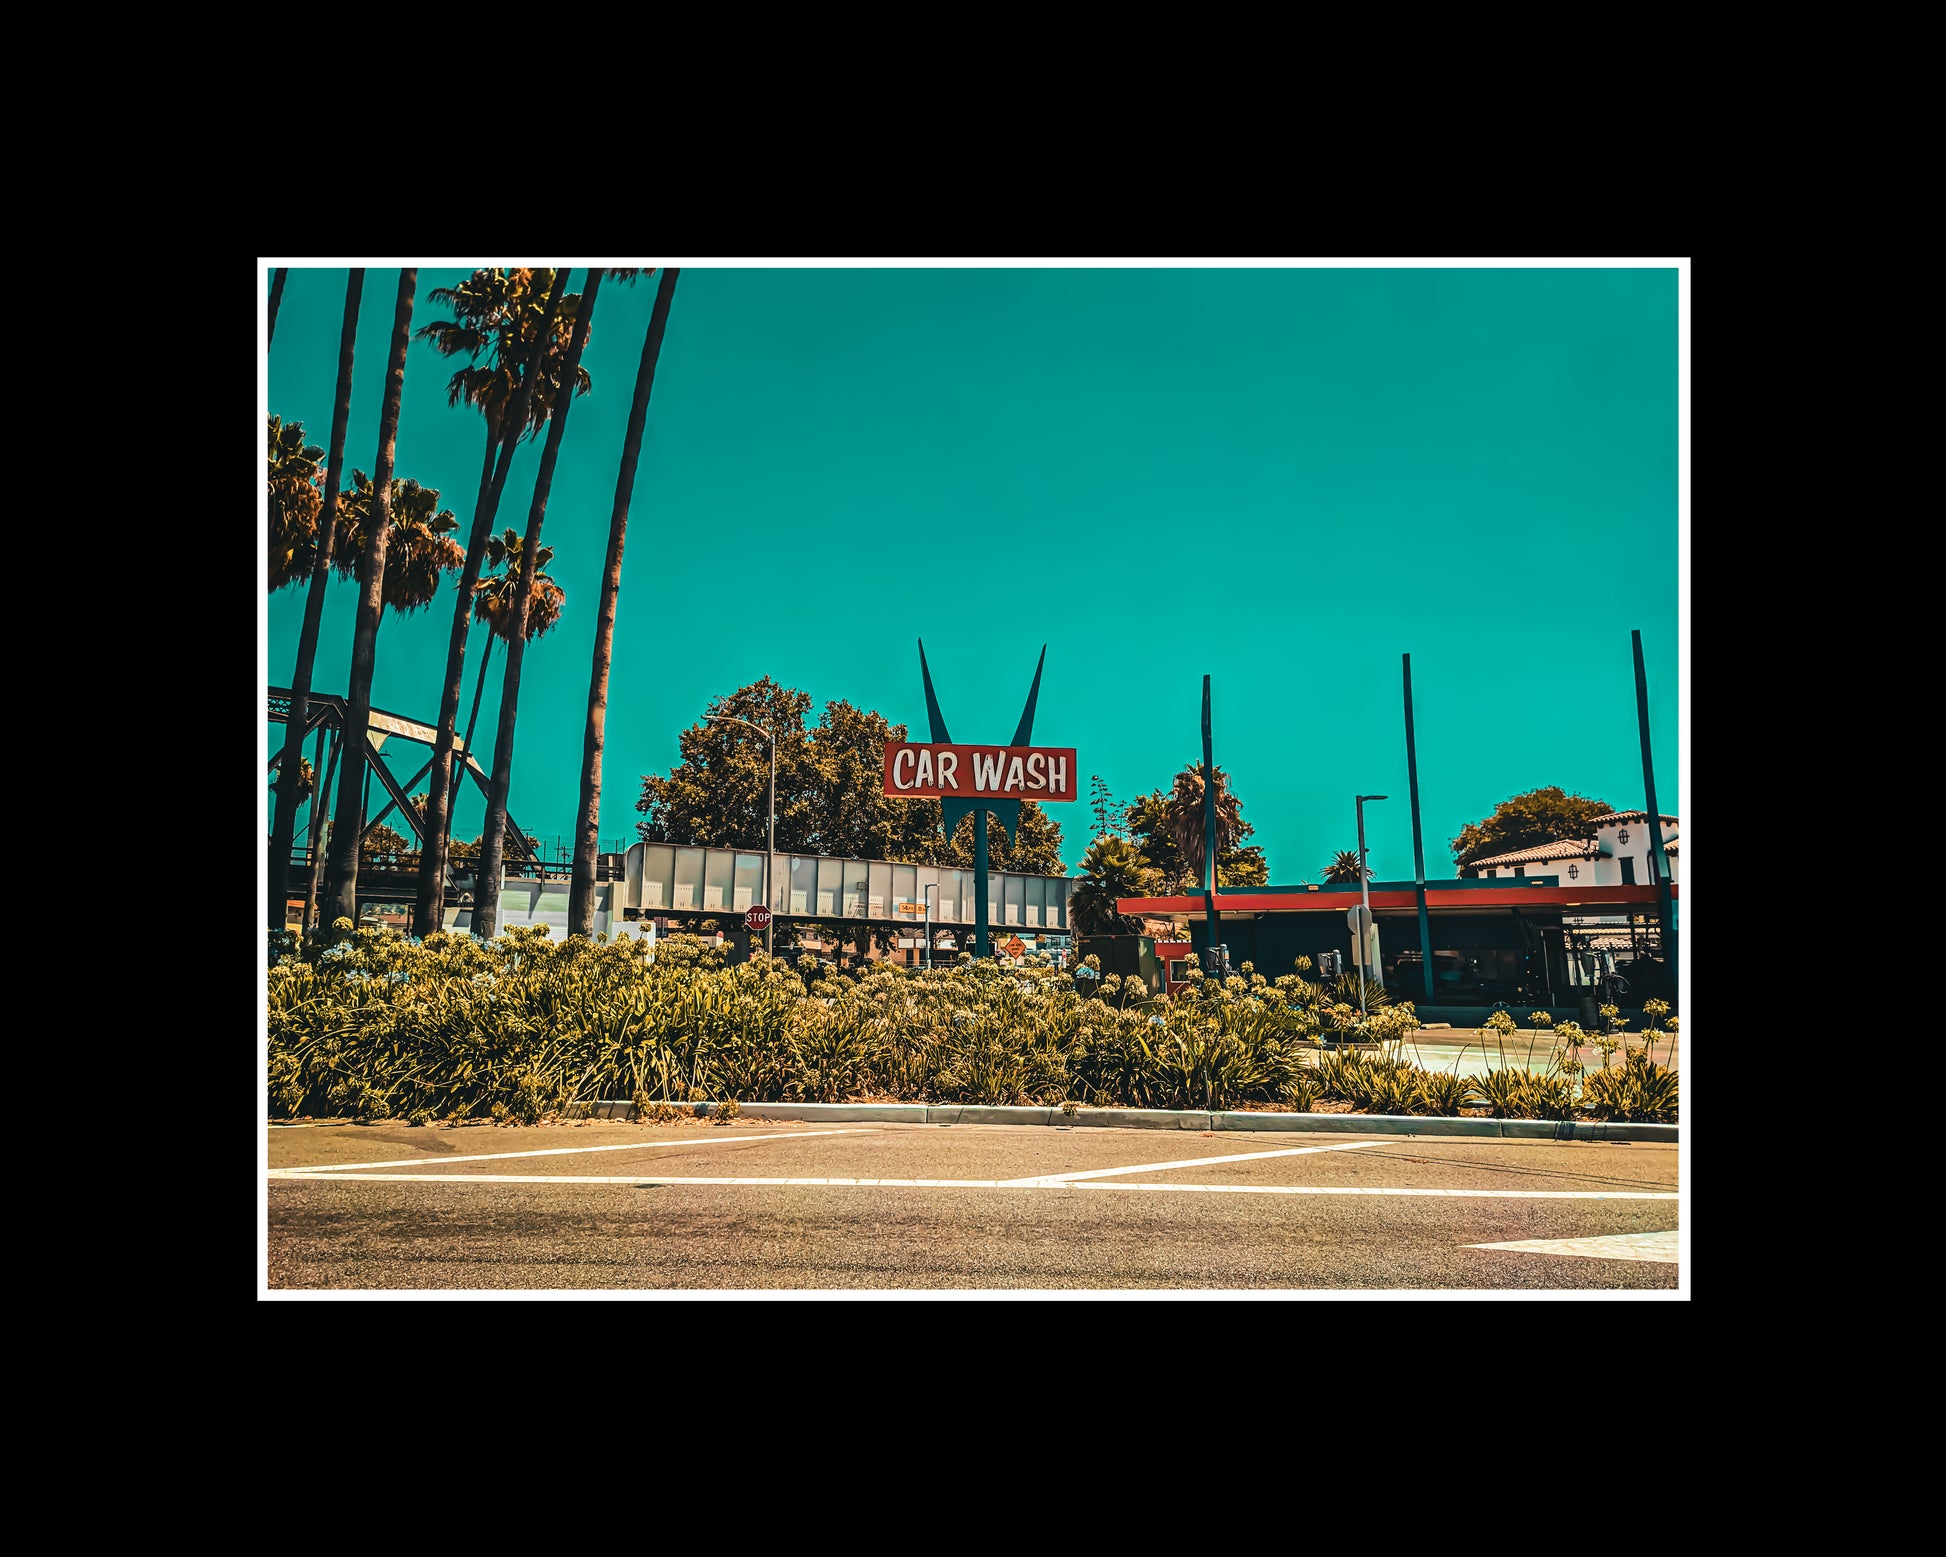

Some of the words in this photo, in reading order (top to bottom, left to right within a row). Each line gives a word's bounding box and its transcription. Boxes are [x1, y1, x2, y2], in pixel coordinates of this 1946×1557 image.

[893, 749, 959, 790] CAR
[973, 750, 1066, 793] WASH
[746, 912, 771, 923] STOP
